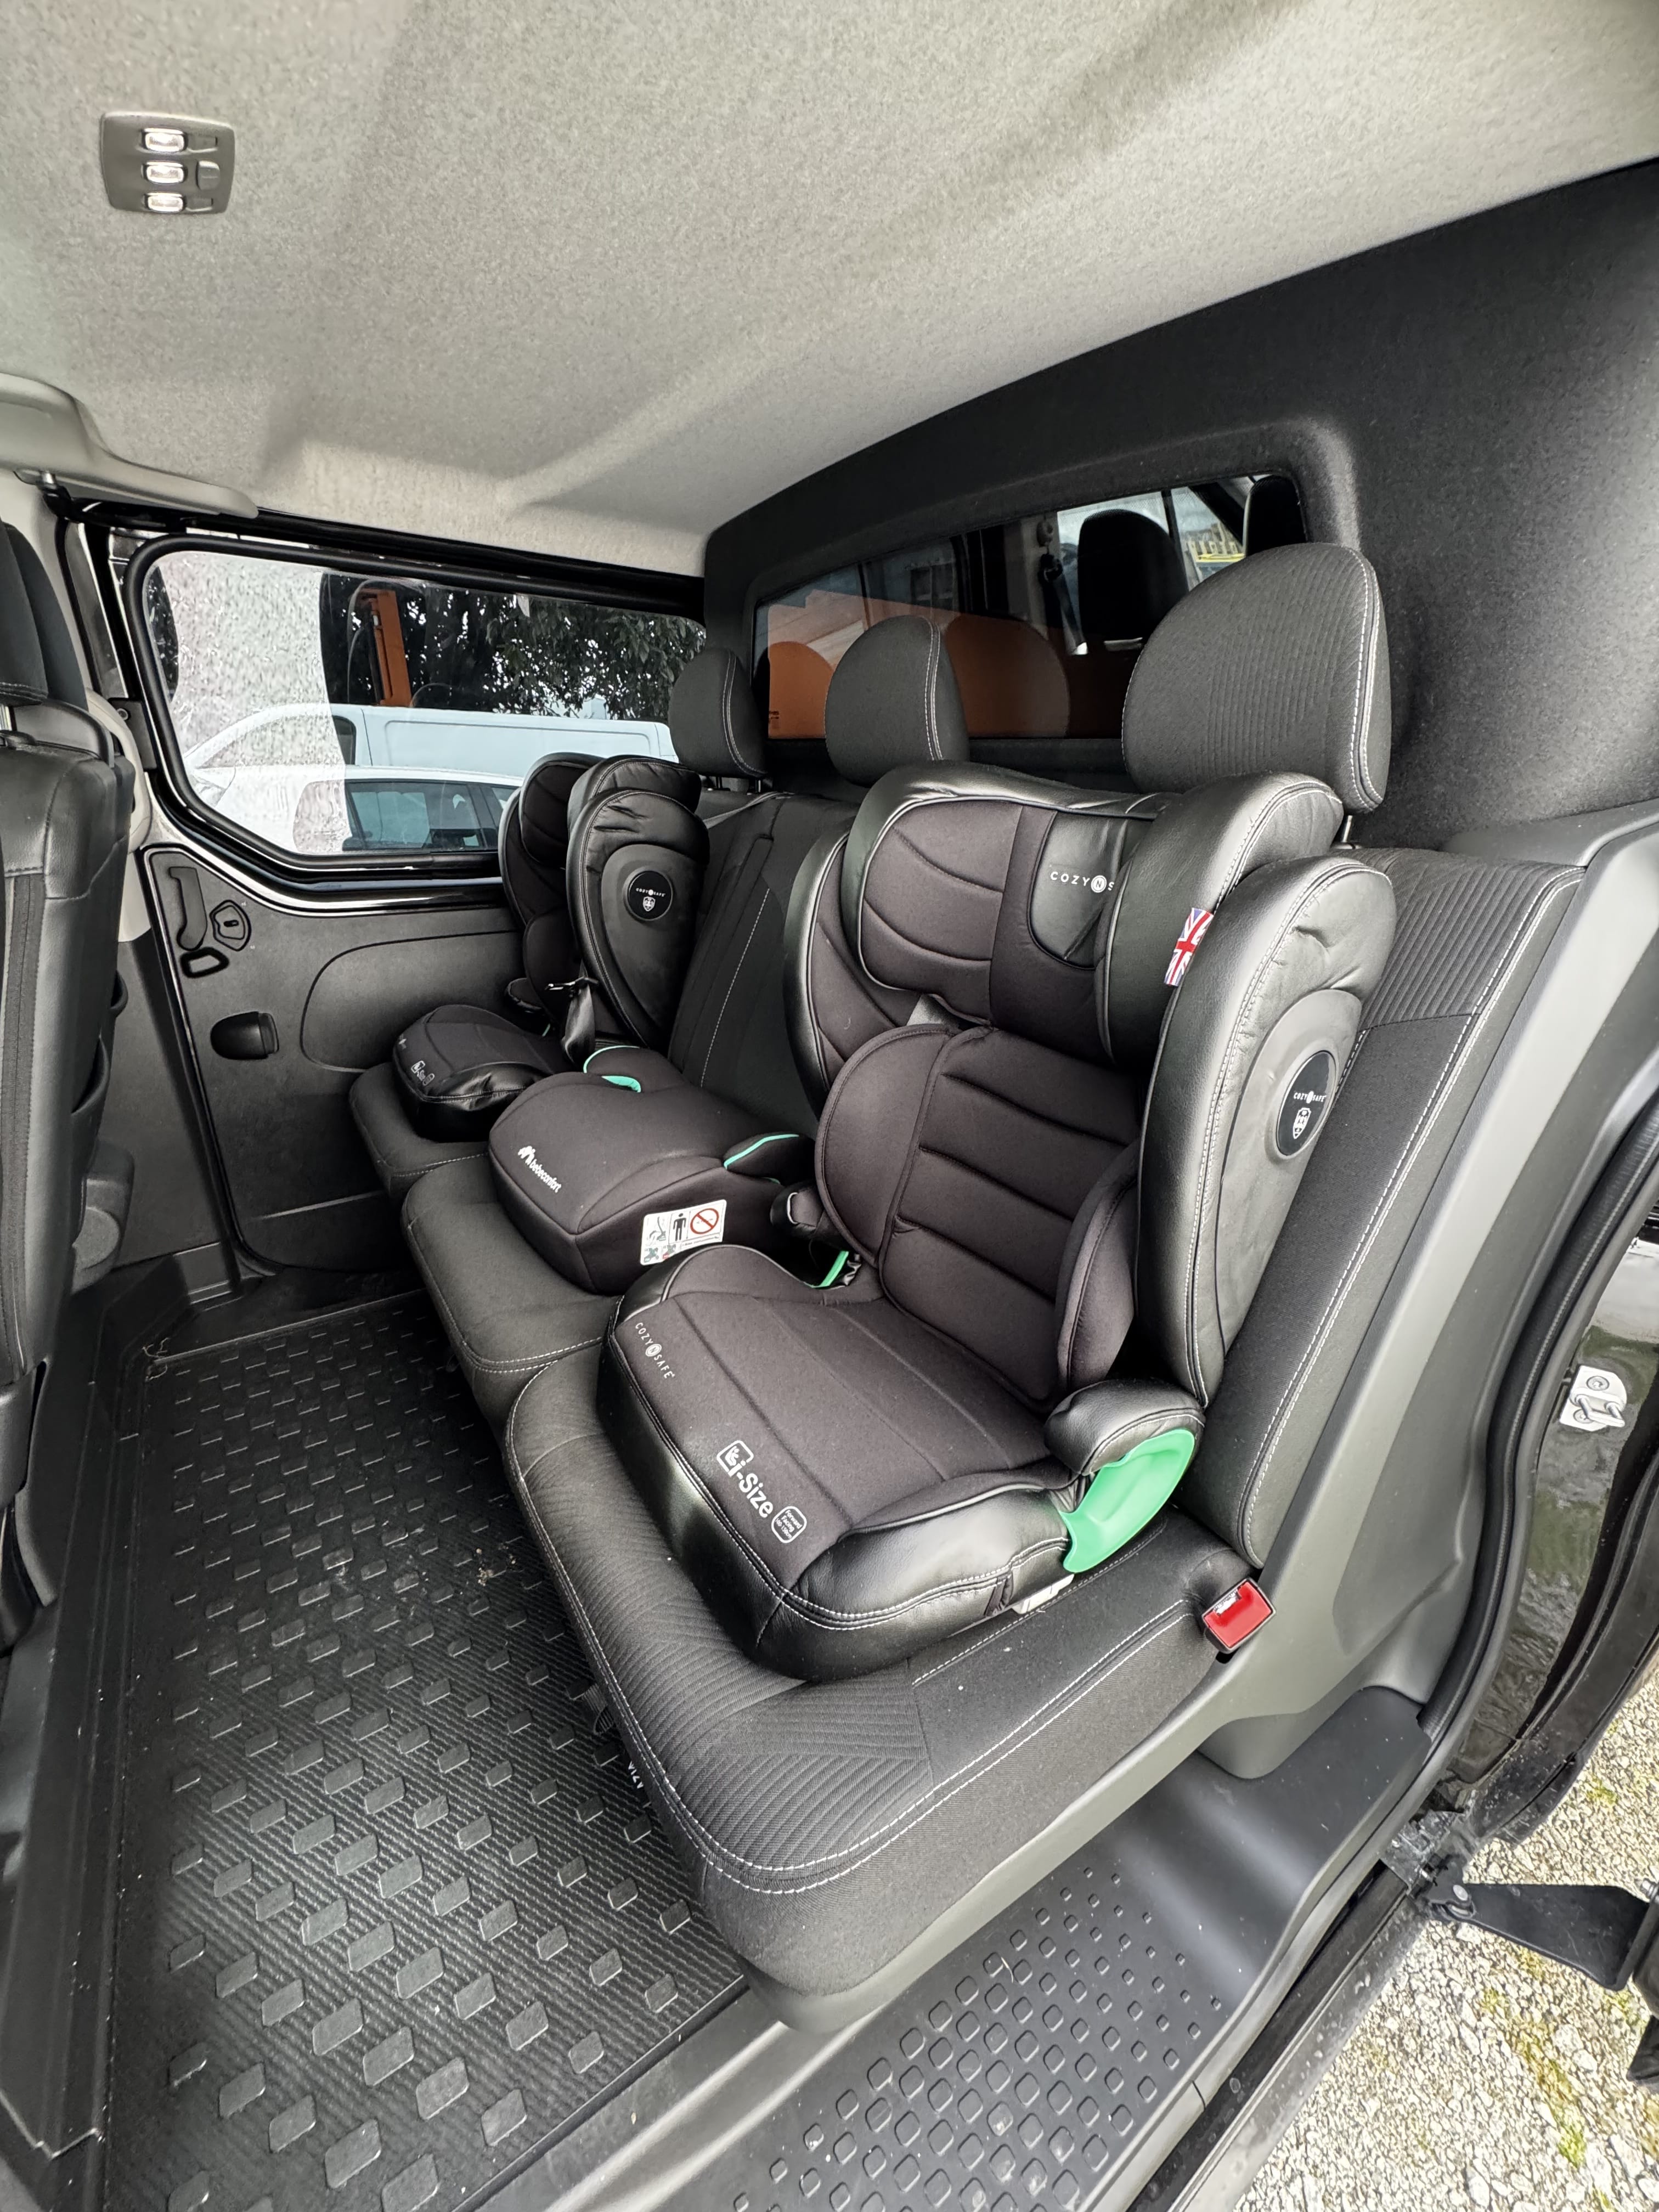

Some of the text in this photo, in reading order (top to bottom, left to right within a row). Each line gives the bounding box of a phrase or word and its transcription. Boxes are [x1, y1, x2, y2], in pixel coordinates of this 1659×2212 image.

[1050, 871, 1090, 887] COZY
[635, 1322, 654, 1345] COZY
[653, 1354, 674, 1379] SAFE
[727, 1460, 774, 1518] i-Size
[781, 1515, 795, 1533] Facing
[785, 1509, 803, 1529] Forward
